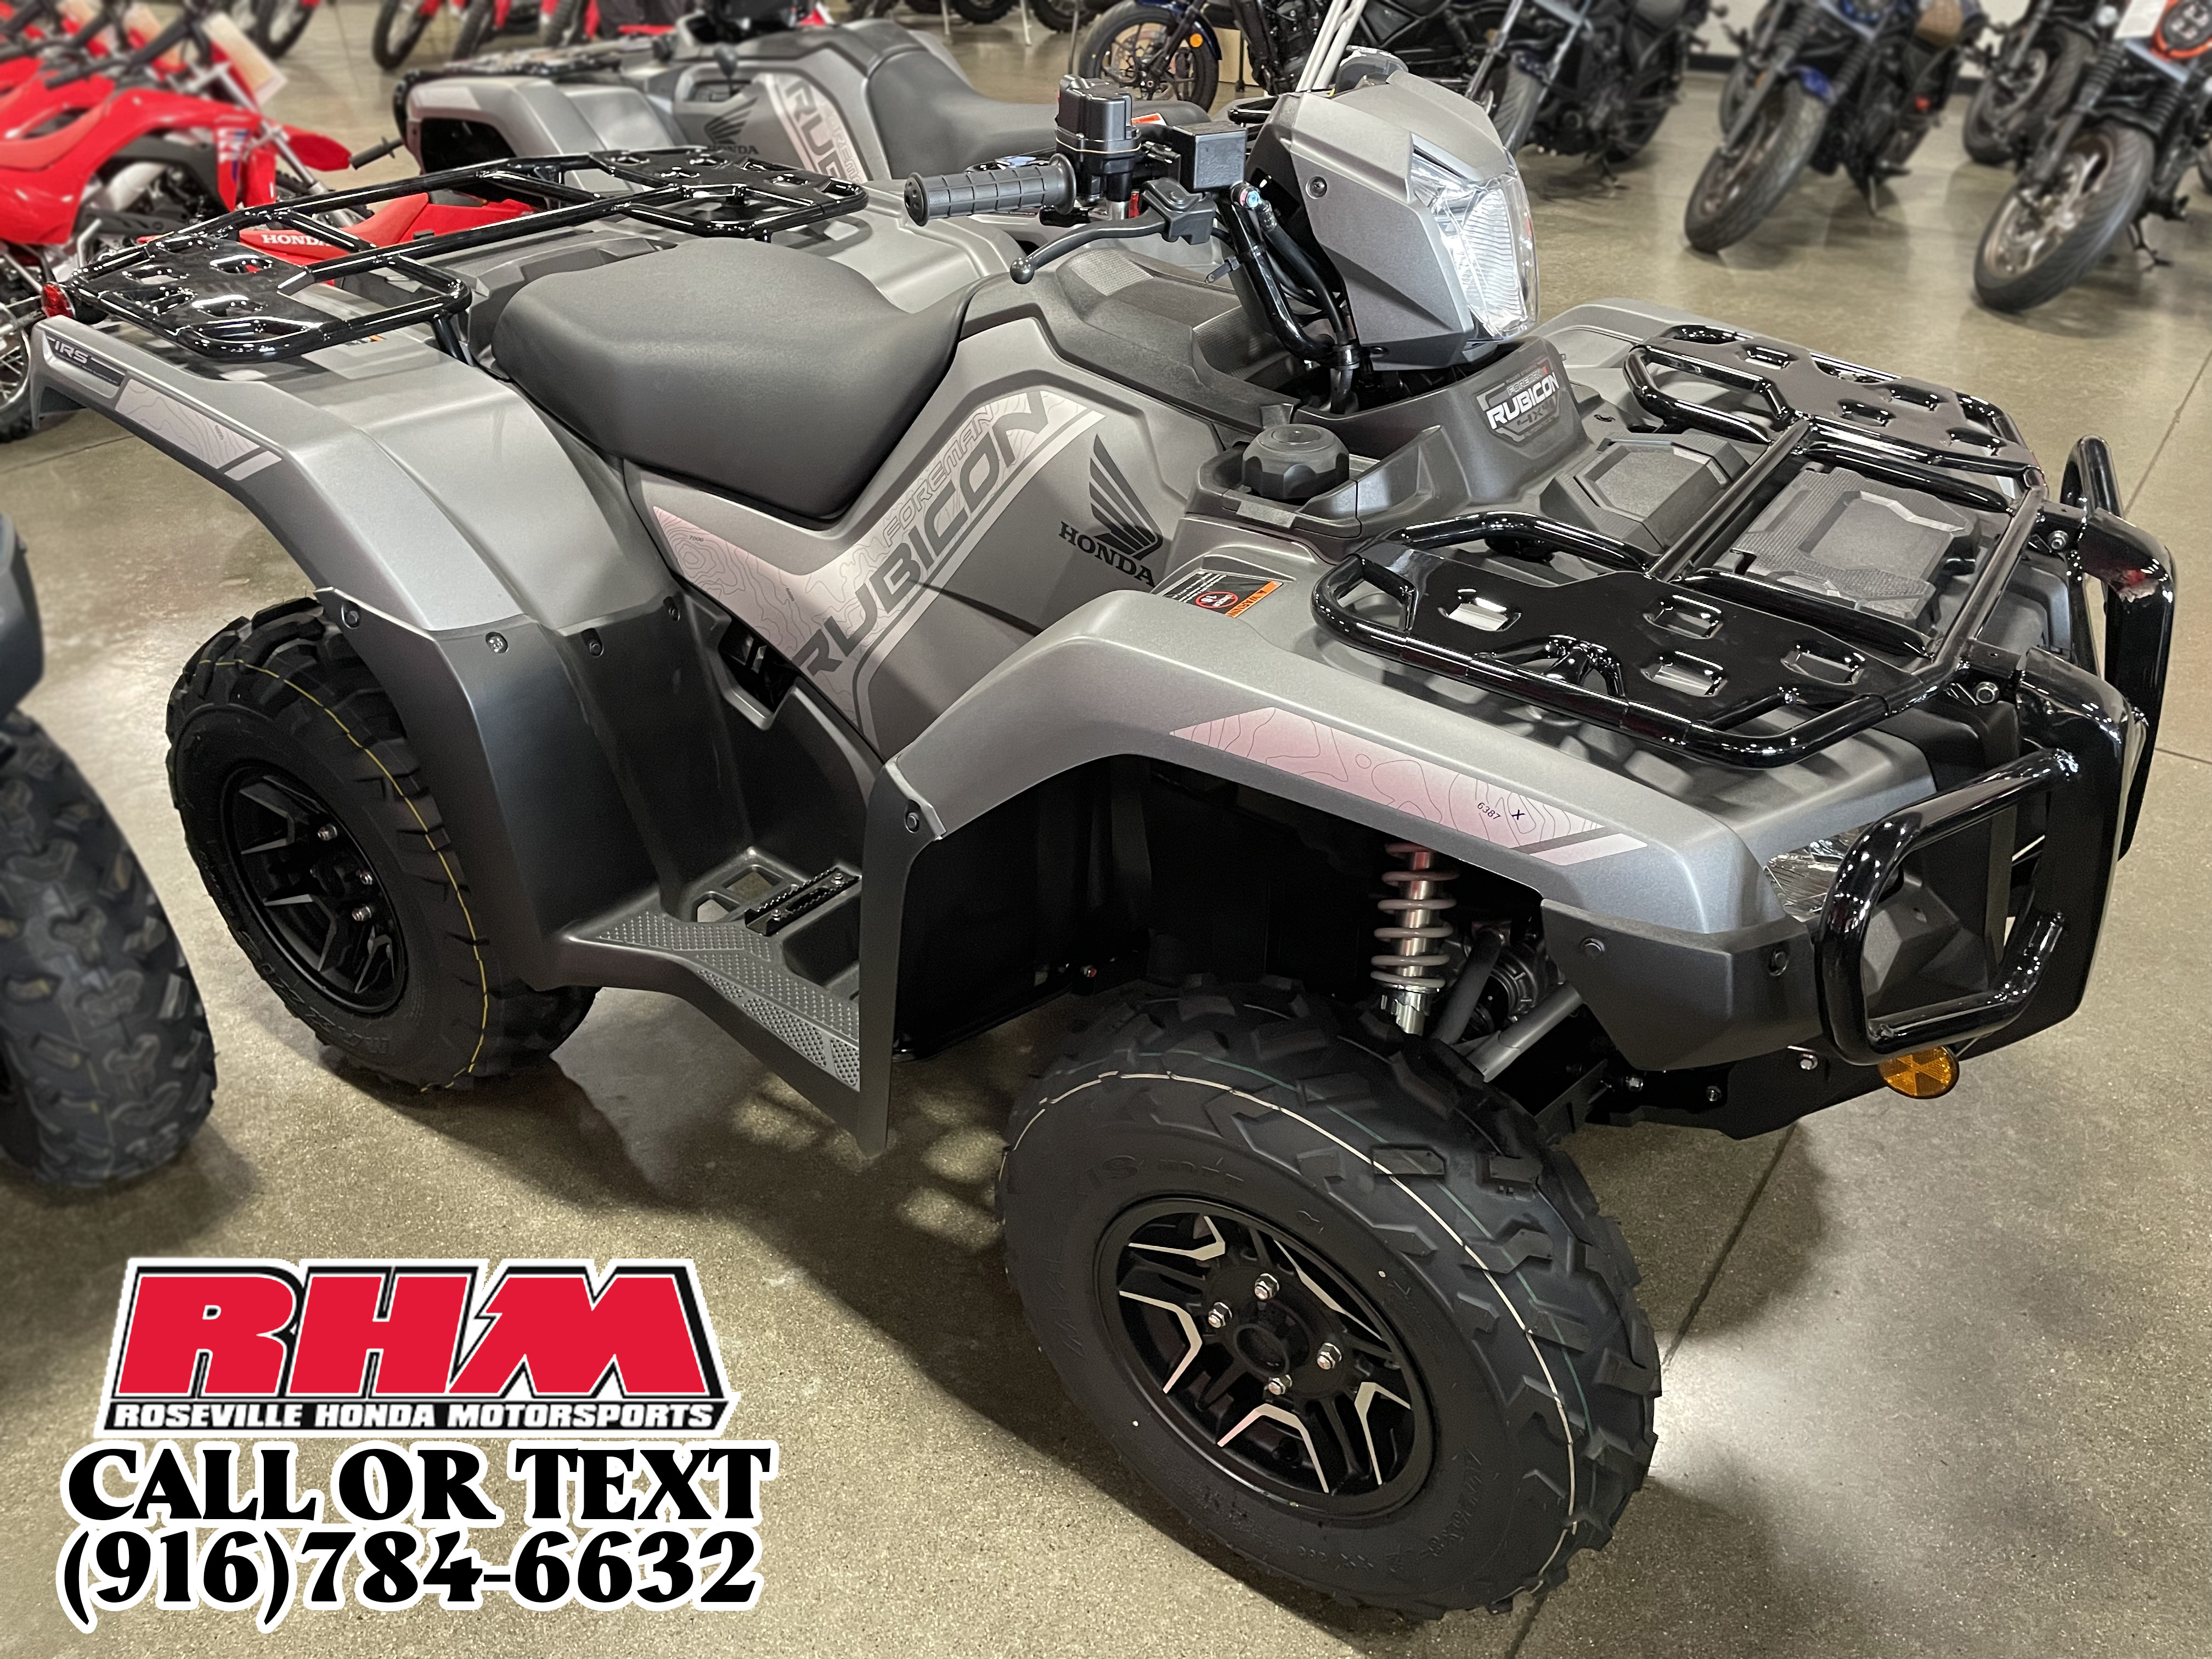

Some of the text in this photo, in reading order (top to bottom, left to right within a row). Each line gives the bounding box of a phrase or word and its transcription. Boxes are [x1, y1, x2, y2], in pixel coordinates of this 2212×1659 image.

[55, 341, 88, 364] IRS
[1486, 372, 1559, 430] RUBICON
[882, 404, 994, 548] FOREMAN
[790, 391, 1049, 676] RUBICON
[1058, 521, 1156, 588] HONDA
[1477, 802, 1501, 820] 6387
